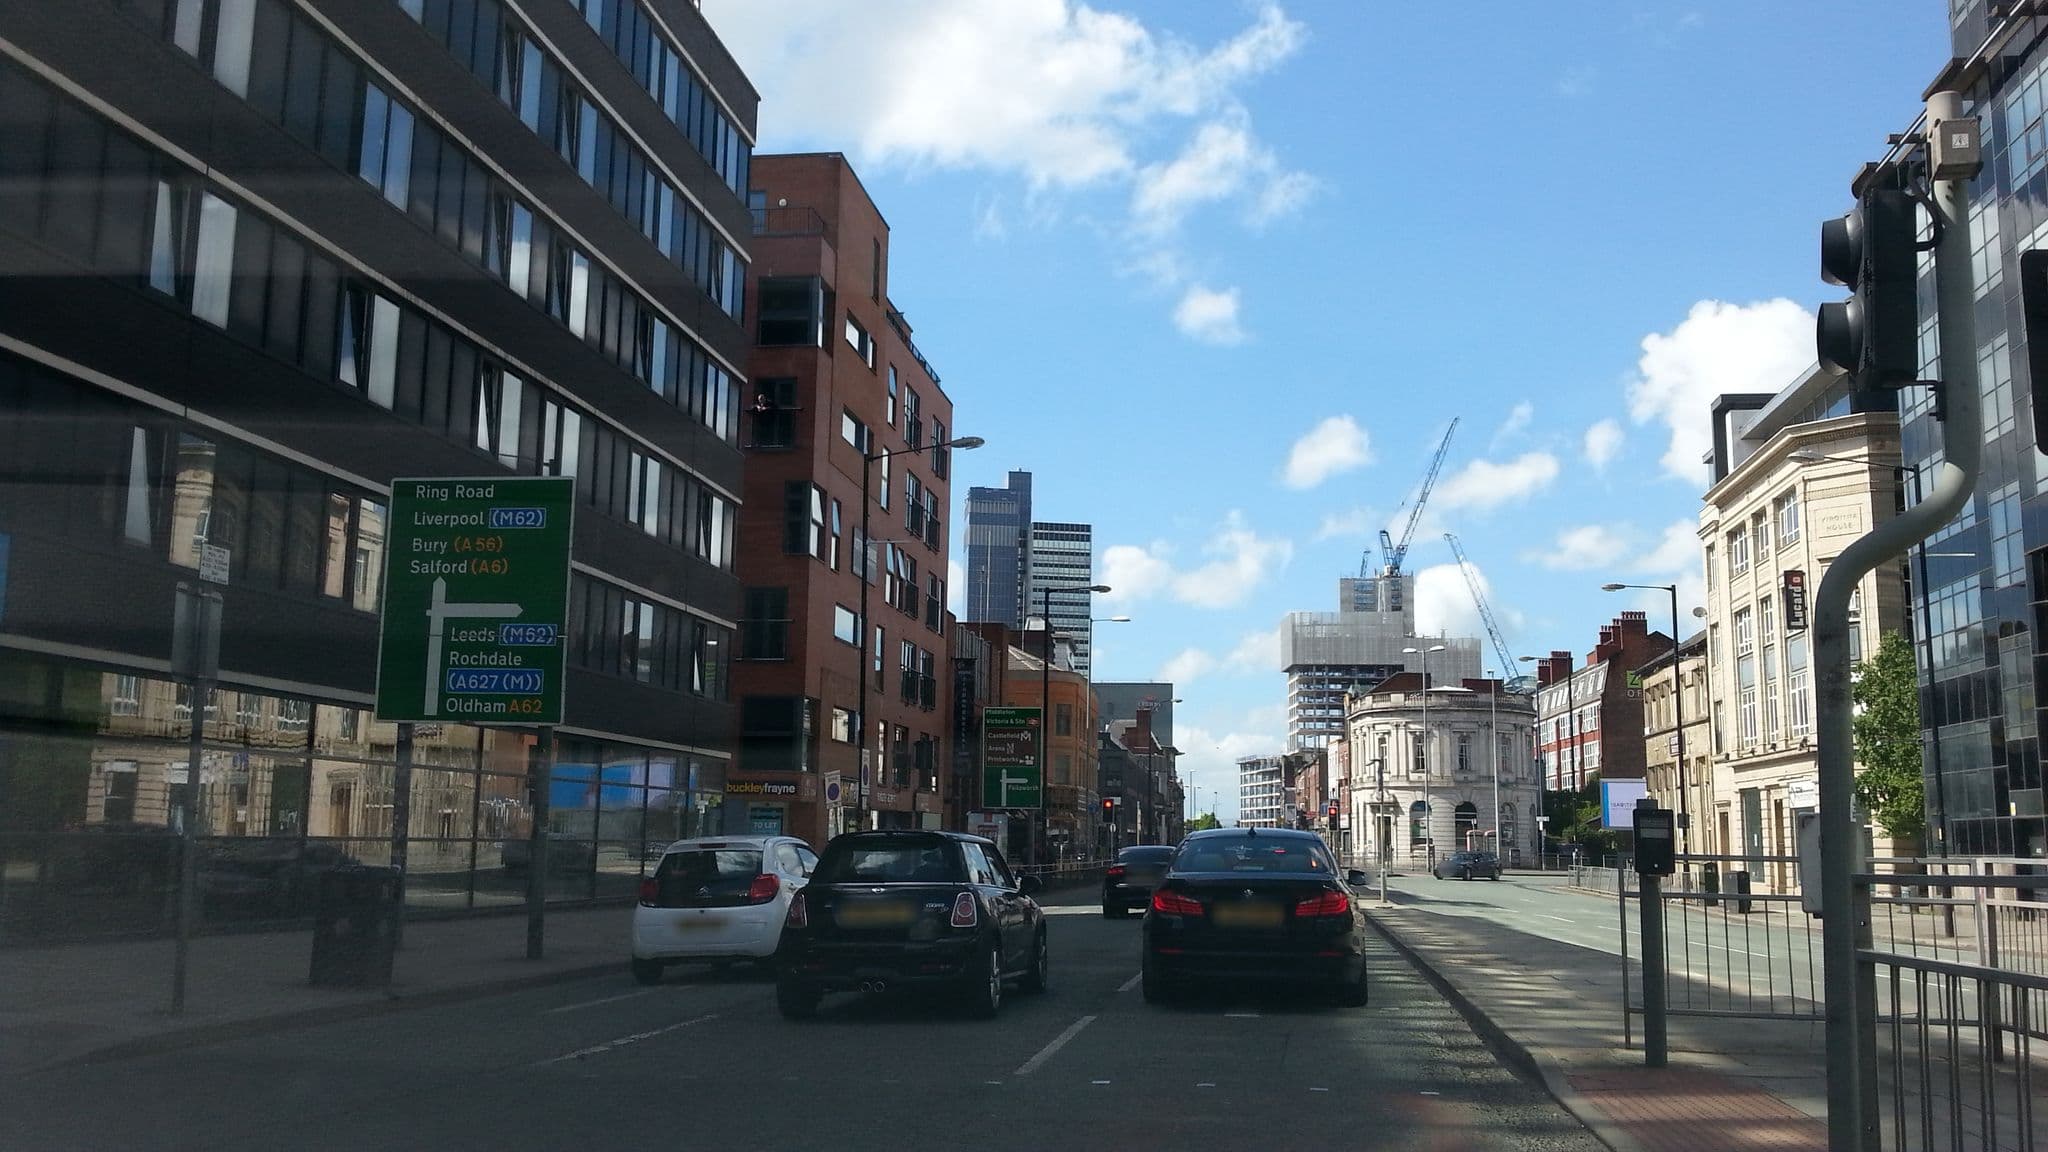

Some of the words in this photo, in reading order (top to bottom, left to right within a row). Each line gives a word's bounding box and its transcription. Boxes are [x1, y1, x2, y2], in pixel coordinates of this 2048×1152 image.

[416, 484, 449, 501] Ring
[455, 484, 495, 499] Road
[413, 511, 485, 528] Liverpool
[491, 510, 544, 527] (M62)
[412, 538, 448, 555] Bury
[410, 559, 468, 574] Salford
[471, 558, 510, 575] (A6)
[1791, 575, 1805, 626] Lucardo
[450, 627, 495, 642] Leeds
[501, 626, 555, 644] (M62)
[449, 651, 522, 666] Rochdale
[446, 697, 506, 713] Oldham
[509, 699, 542, 714] A62
[753, 821, 763, 829] TO
[764, 821, 777, 829] LET
